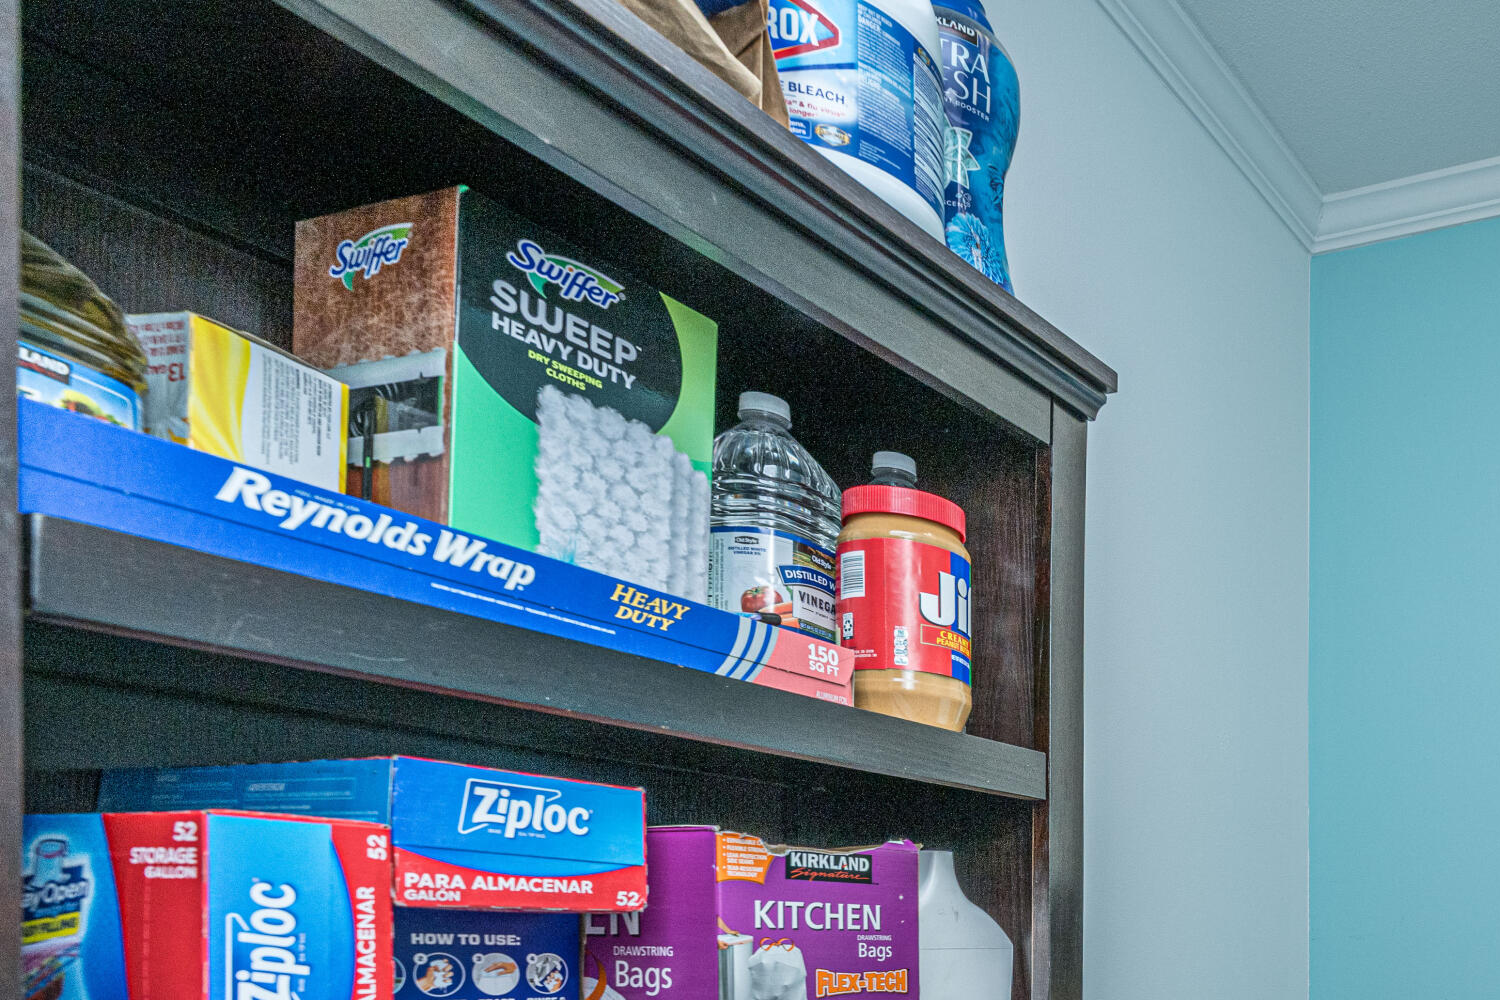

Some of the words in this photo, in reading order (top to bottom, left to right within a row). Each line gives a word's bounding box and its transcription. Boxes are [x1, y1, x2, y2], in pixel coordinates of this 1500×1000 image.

[767, 6, 819, 46] ROX
[936, 17, 975, 37] KLAND
[940, 38, 991, 85] TRA
[788, 81, 845, 104] BLEACH
[330, 237, 408, 279] Swiffer
[506, 240, 619, 309] Swiffer
[490, 280, 638, 365] SWEEP
[491, 312, 572, 361] HEAVY
[577, 348, 636, 389] DUTY
[528, 350, 551, 366] DRY
[551, 360, 602, 388] SWEEPING
[546, 368, 585, 390] CLOTHS
[215, 466, 432, 557] Reynolds
[432, 529, 535, 590] Wrap
[784, 569, 828, 587] DISTILLED
[610, 583, 690, 620] HEAVY
[798, 590, 836, 613] VINEGA
[615, 605, 675, 631] DUTY
[808, 643, 839, 667] 150
[809, 660, 825, 673] SQ
[826, 663, 839, 677] FT
[471, 786, 590, 838] Ziploc
[173, 821, 198, 842] 52
[129, 847, 198, 865] STORAGE
[366, 835, 388, 861] 52
[144, 866, 198, 879] GALLON
[790, 852, 870, 872] KIRKLAND
[404, 872, 466, 891] PARA
[471, 875, 593, 895] ALMACENAR
[790, 867, 870, 881] Signature
[404, 888, 461, 902] GALÓN
[616, 891, 640, 907] 52
[754, 900, 881, 930] KITCHEN
[411, 933, 455, 945] HOW
[457, 933, 480, 945] TO
[483, 934, 521, 946] USE:
[613, 946, 674, 957] DRAWSTRING
[858, 942, 892, 961] Bags
[615, 960, 673, 996] Bags
[816, 968, 909, 998] FLEX-TECH
